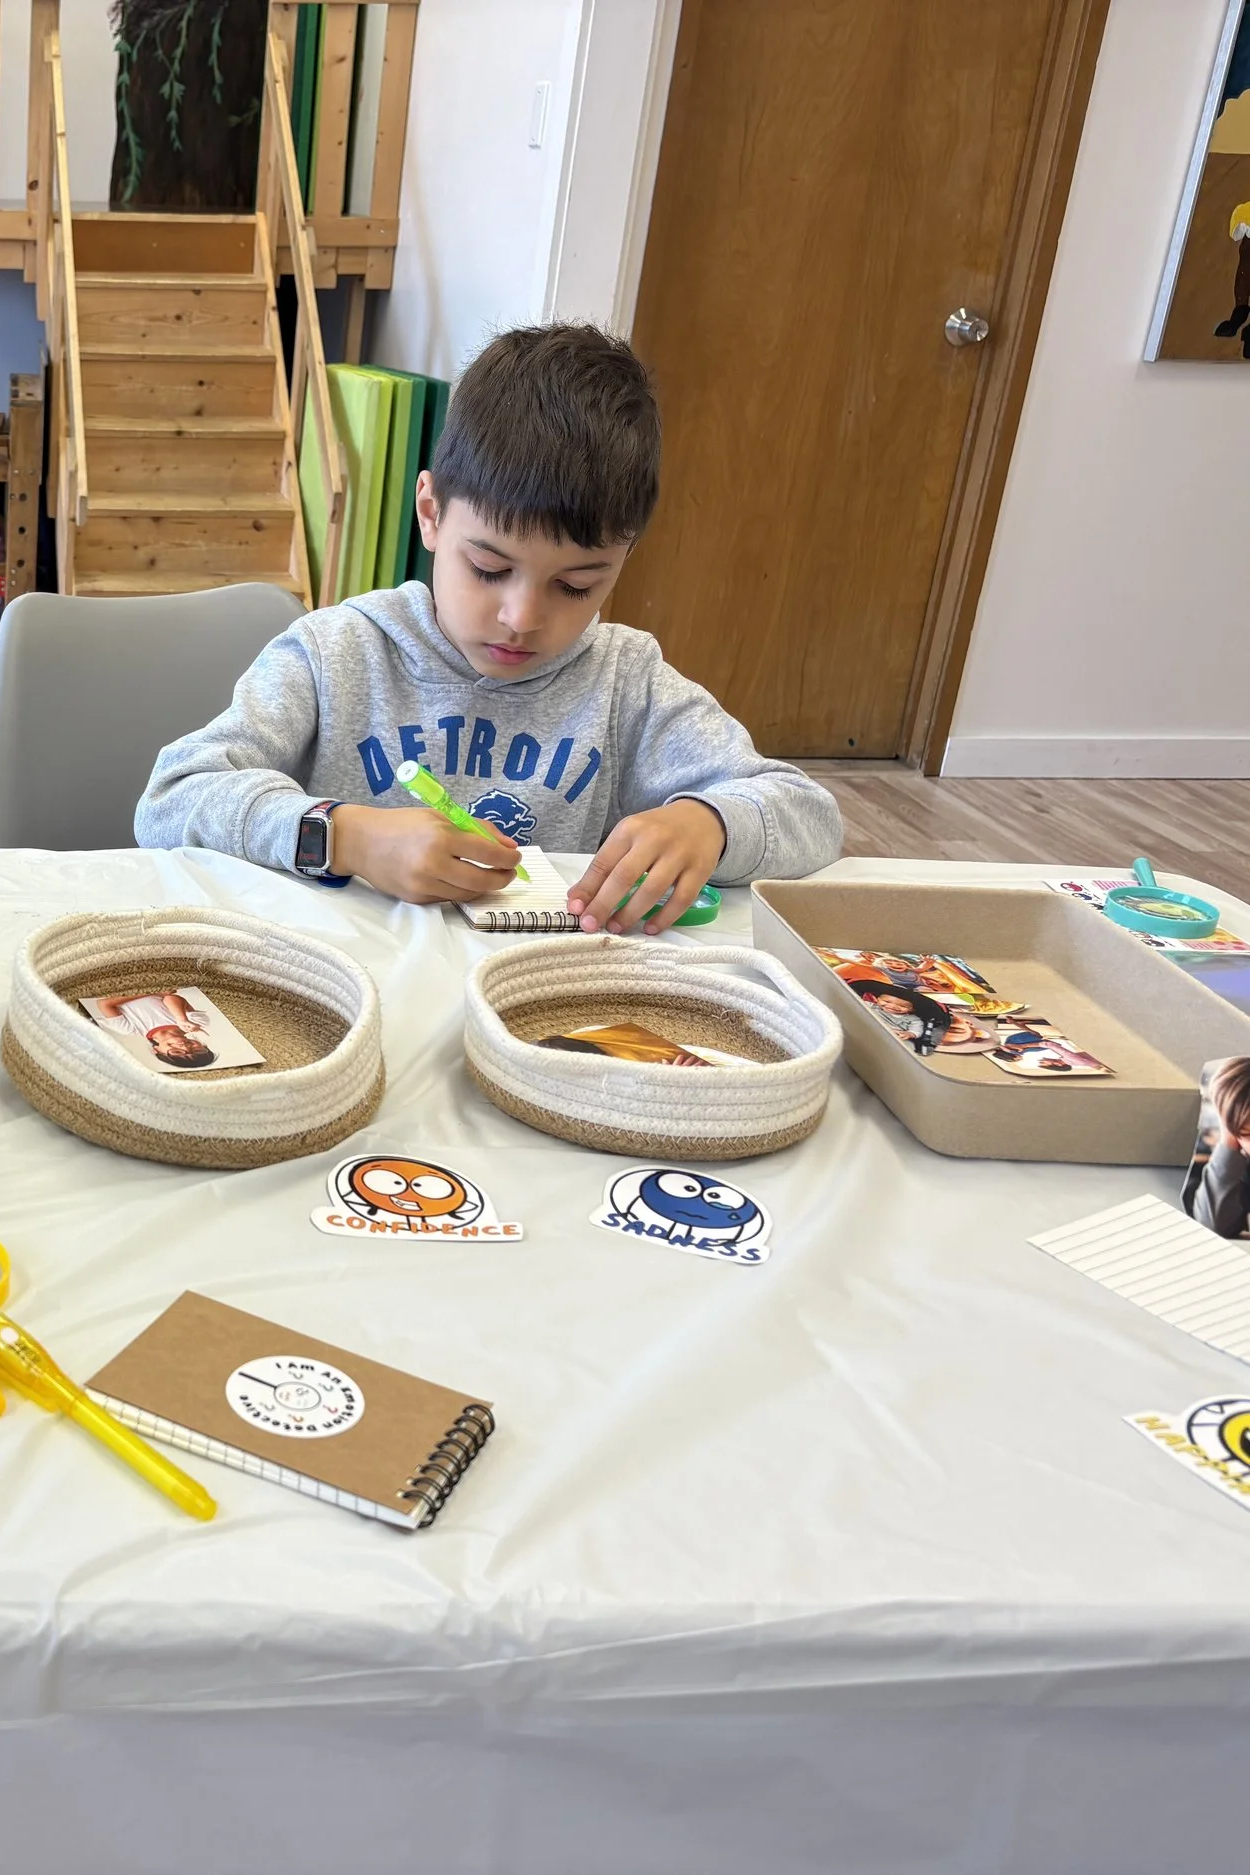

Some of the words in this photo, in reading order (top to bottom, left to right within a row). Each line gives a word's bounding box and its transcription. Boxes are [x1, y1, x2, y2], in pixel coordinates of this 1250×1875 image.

[357, 715, 601, 804] DETROIT
[326, 1214, 520, 1238] CONFIDENCE
[601, 1212, 762, 1262] SADNESS
[275, 1362, 283, 1370] I
